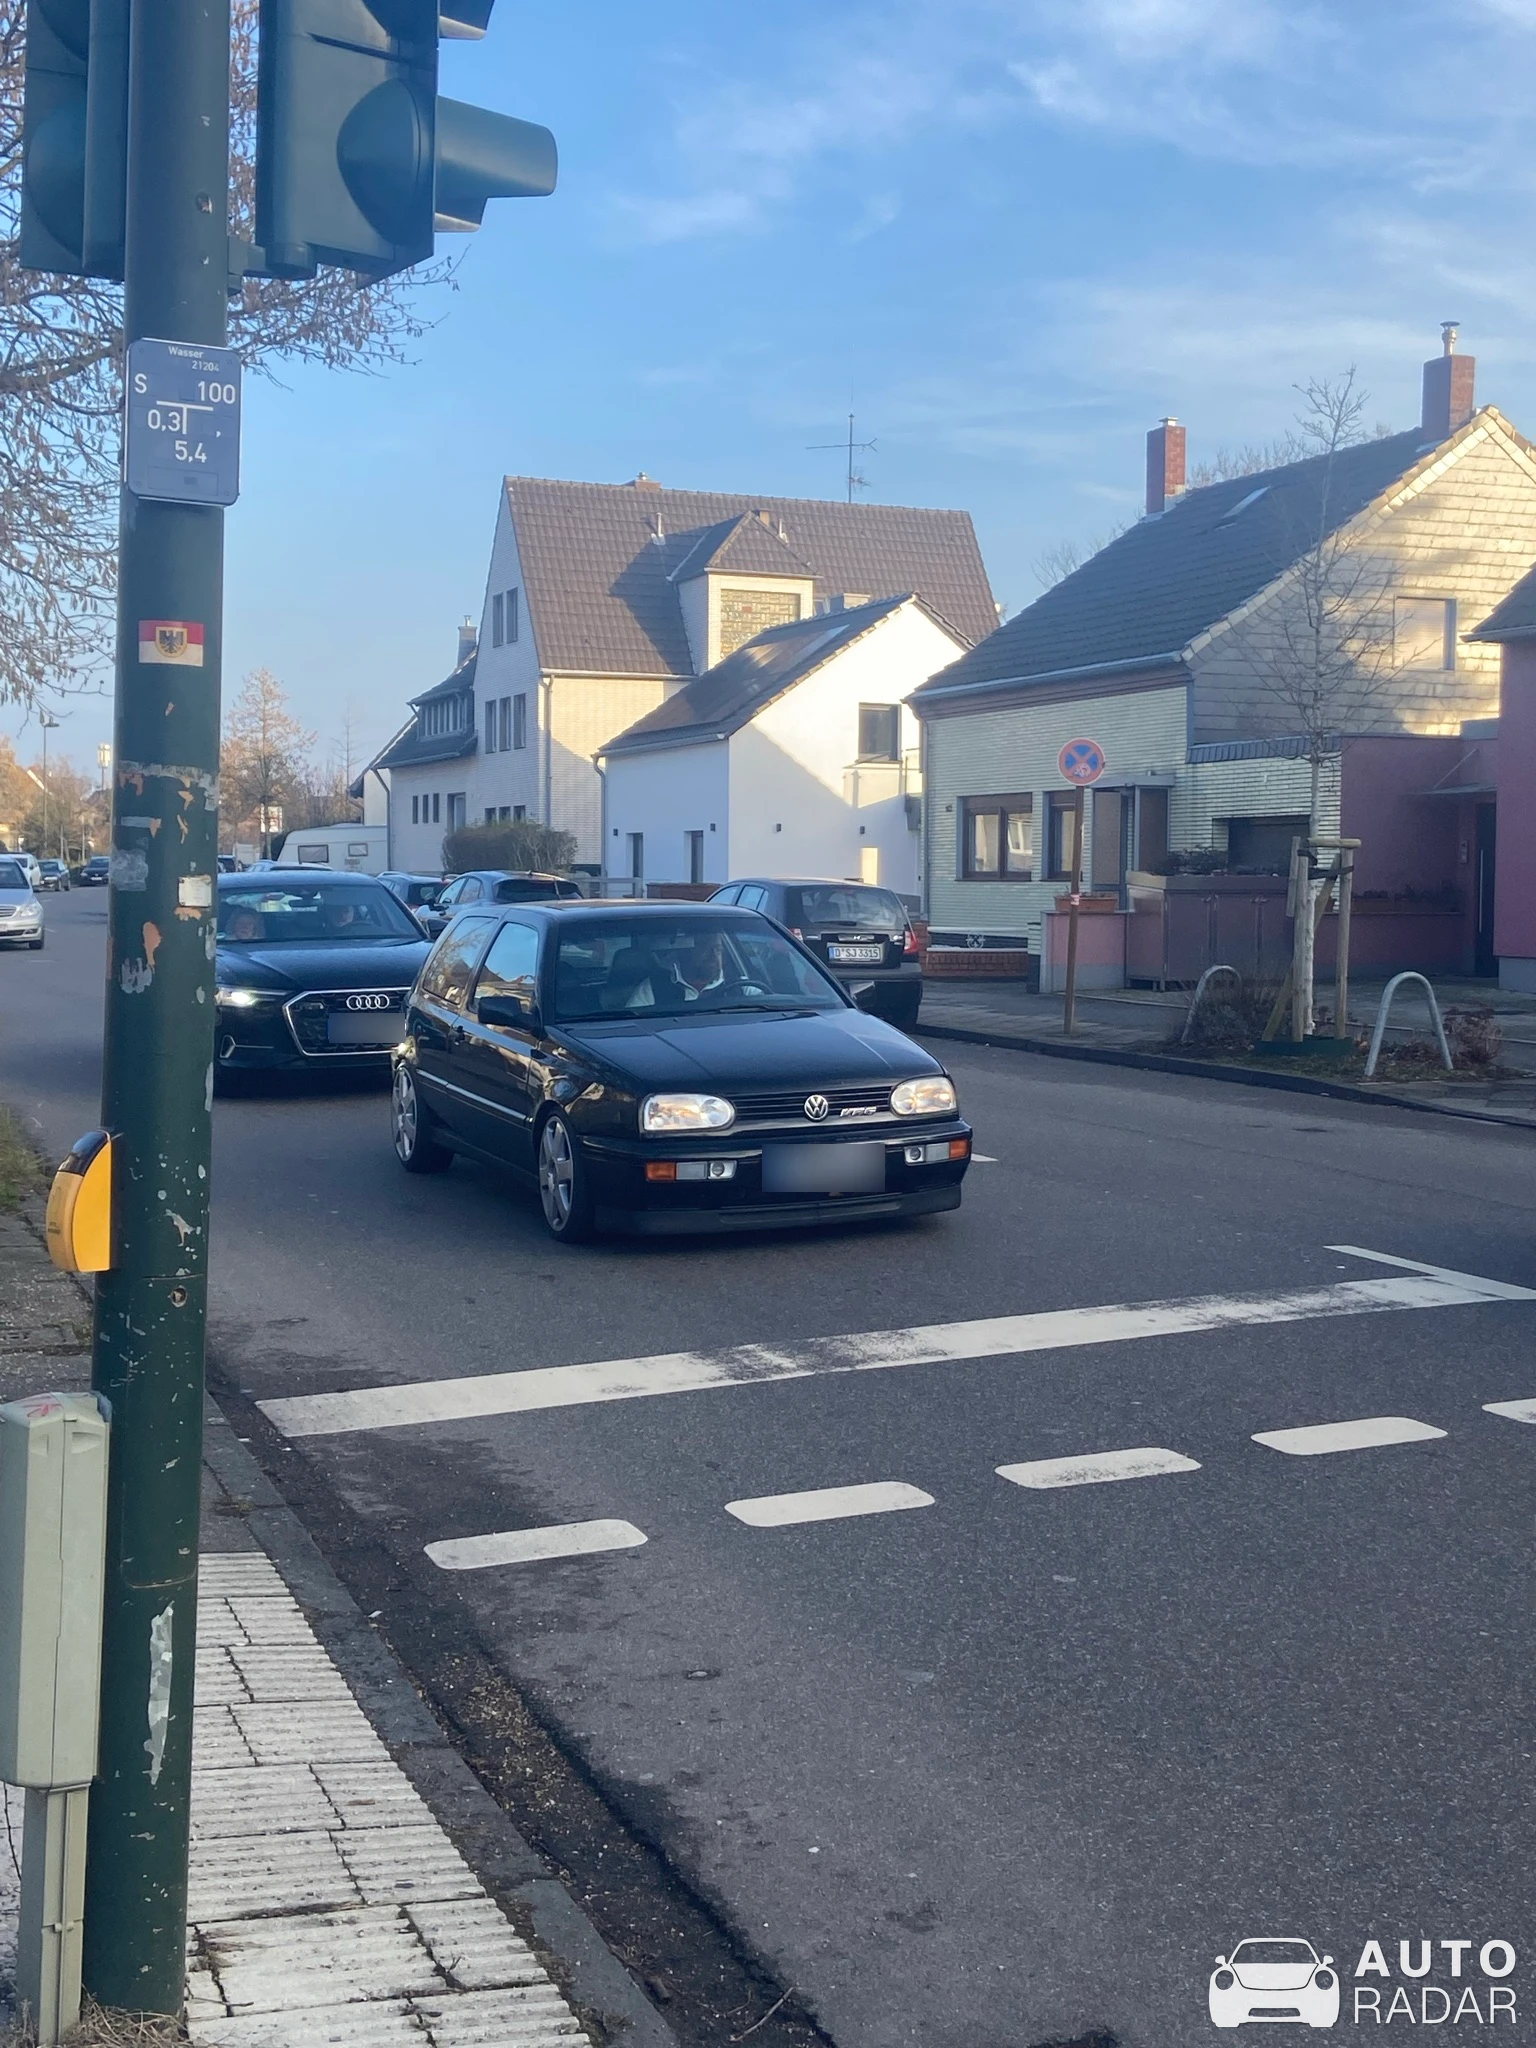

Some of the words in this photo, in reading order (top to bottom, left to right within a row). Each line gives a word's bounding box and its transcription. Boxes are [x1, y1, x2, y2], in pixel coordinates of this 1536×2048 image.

[168, 345, 204, 359] Wasser
[134, 373, 148, 394] S
[198, 380, 236, 404] 100
[147, 409, 181, 432] 0,3
[174, 439, 208, 464] 5,4
